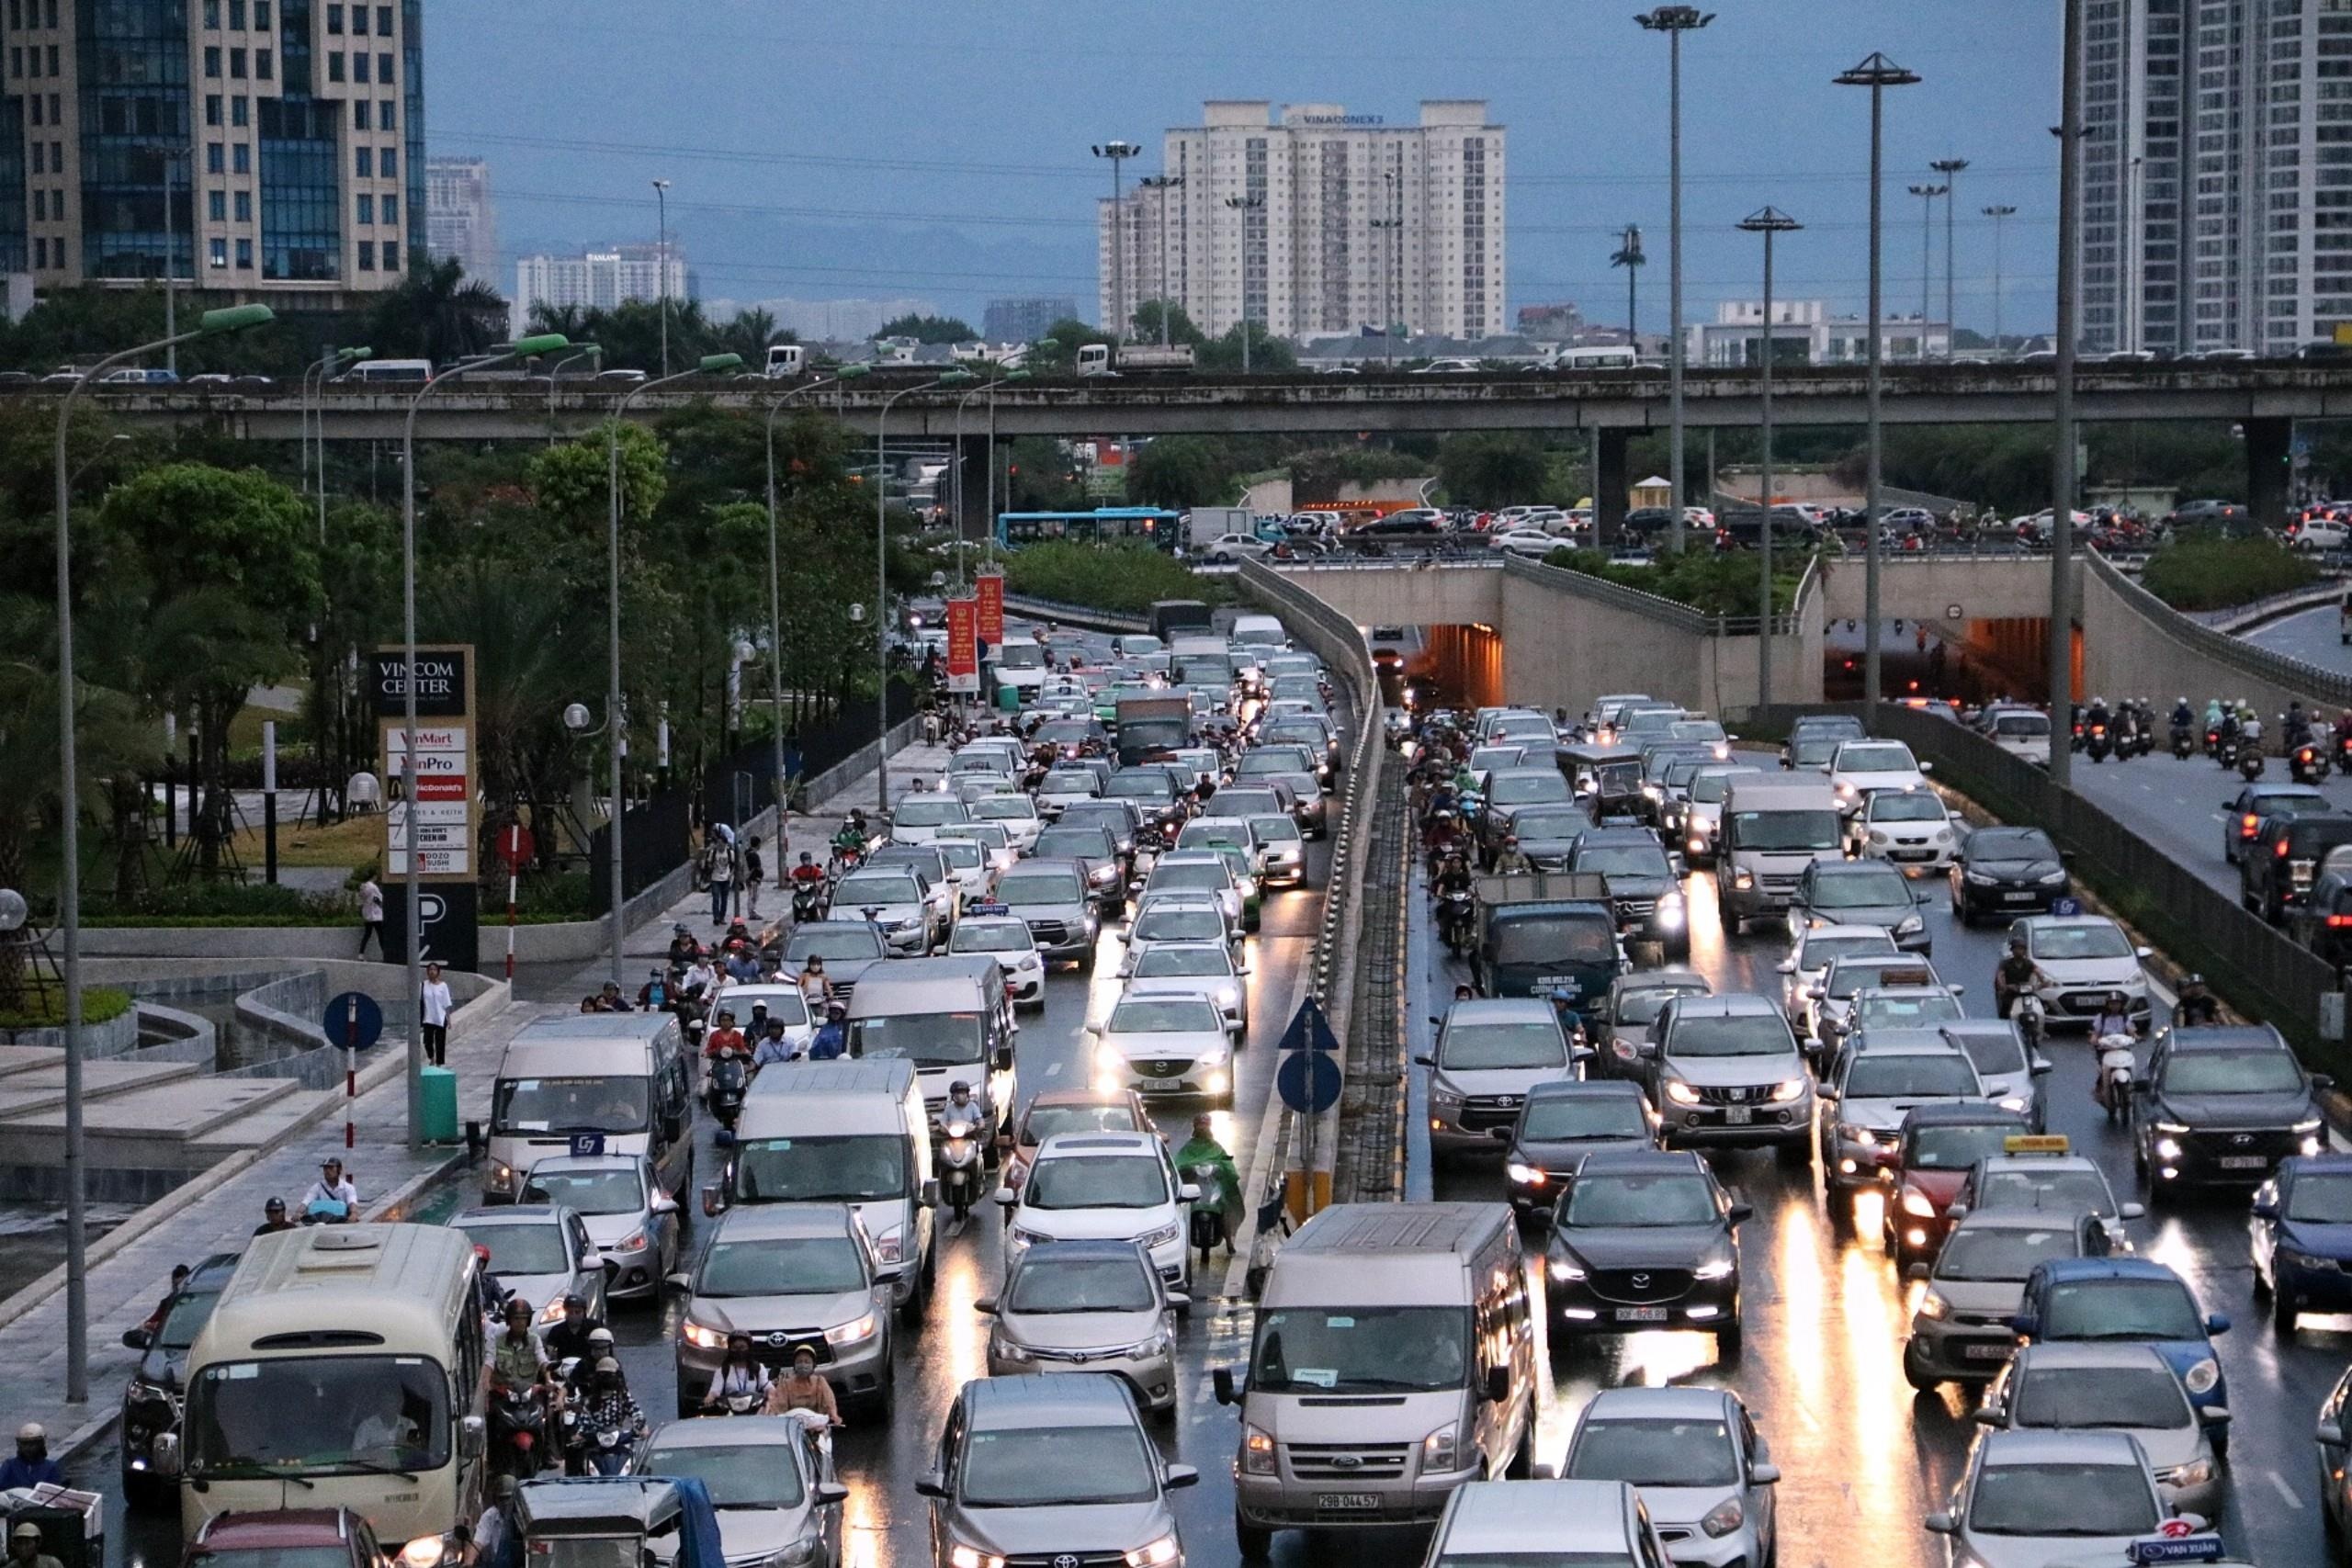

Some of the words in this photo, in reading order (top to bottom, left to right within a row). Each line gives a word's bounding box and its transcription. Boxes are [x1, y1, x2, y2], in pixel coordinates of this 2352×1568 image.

[1304, 115, 1374, 124] VINACONEX
[381, 679, 451, 694] CETER
[401, 732, 452, 744] VnMart
[401, 755, 453, 770] VnPro
